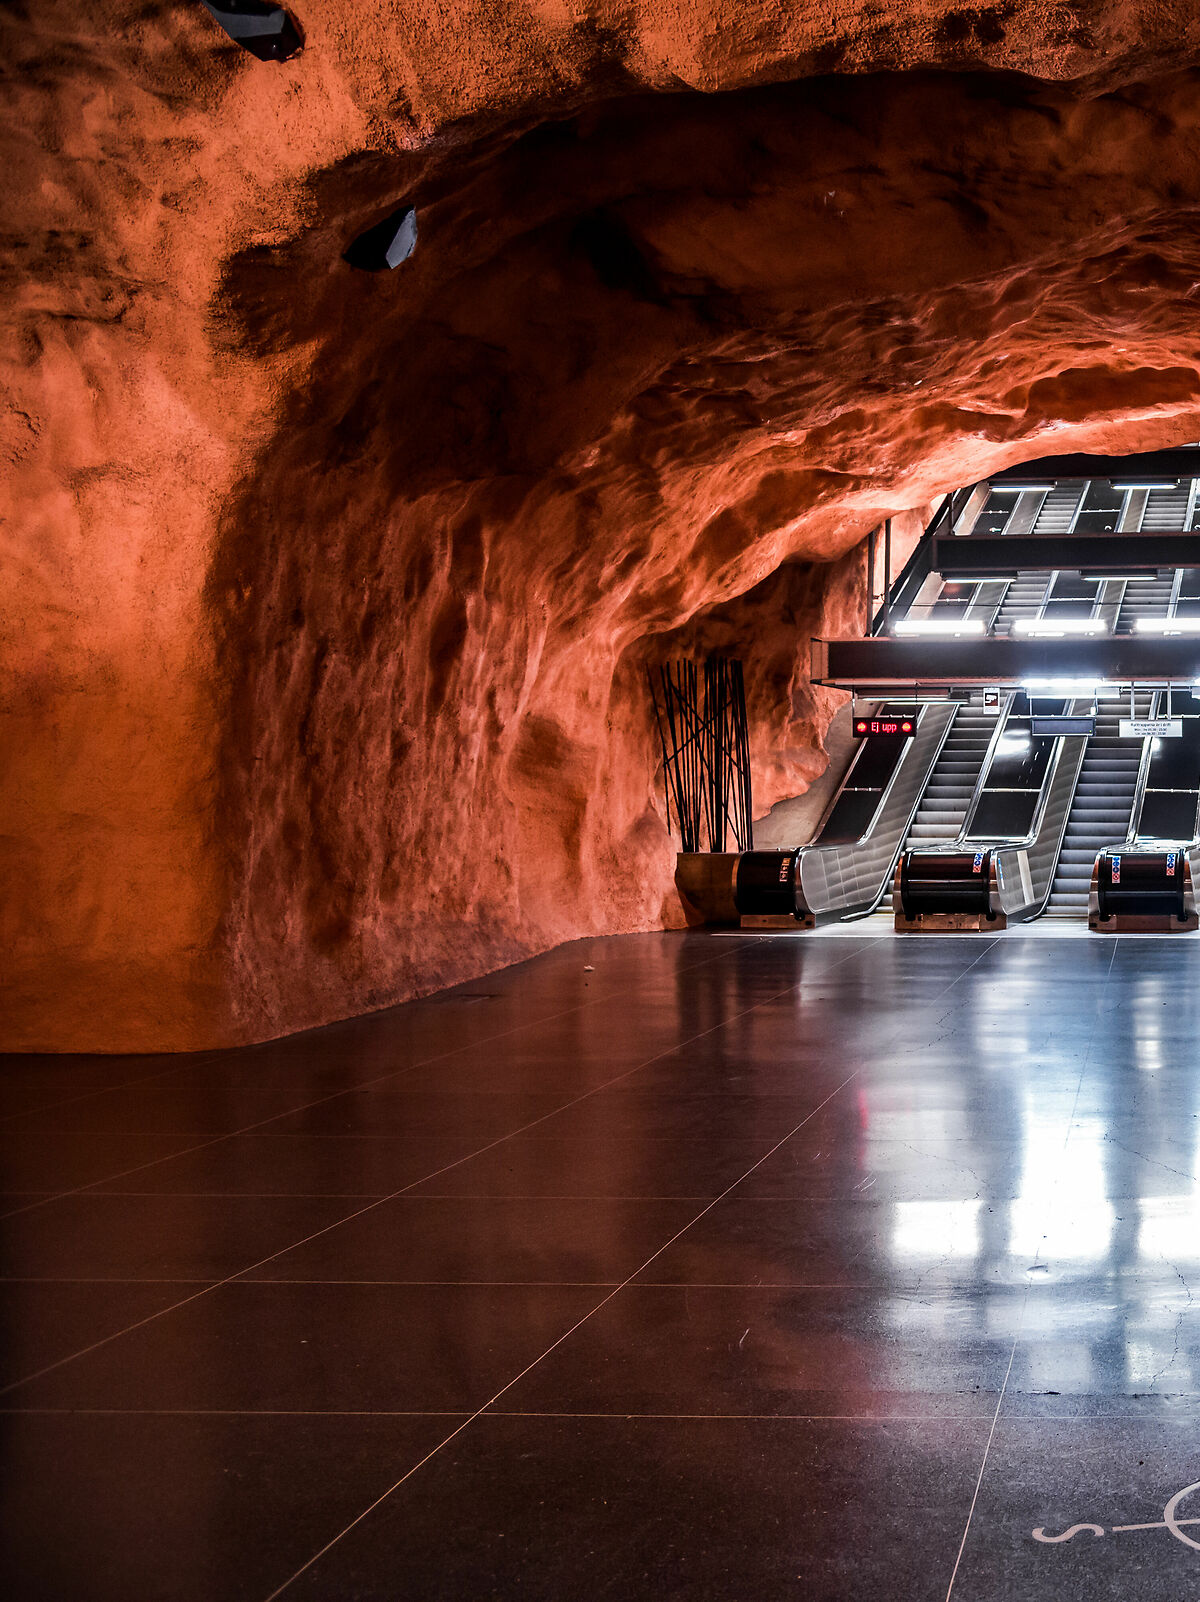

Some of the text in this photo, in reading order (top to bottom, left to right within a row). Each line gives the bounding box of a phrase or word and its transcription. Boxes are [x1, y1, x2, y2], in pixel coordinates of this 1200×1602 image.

[871, 722, 897, 732] Ej upp
[1032, 1523, 1105, 1543] S
